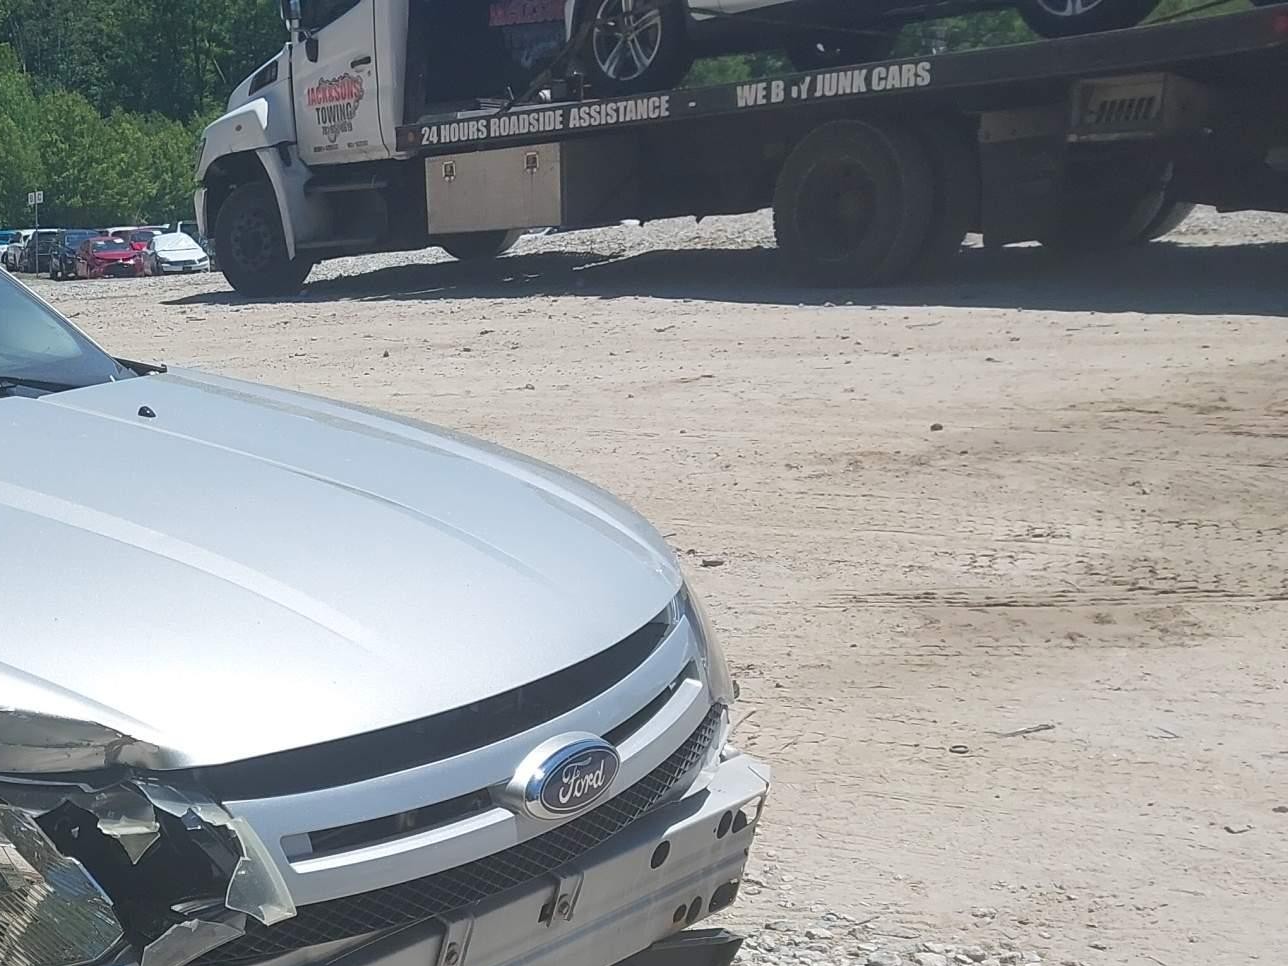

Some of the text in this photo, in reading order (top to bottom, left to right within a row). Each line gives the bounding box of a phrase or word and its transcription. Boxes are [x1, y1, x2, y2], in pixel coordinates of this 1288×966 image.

[736, 61, 931, 108] WE BY JUNK CARS
[315, 102, 353, 125] TOWING
[421, 126, 439, 145] 24
[440, 119, 488, 143] HOURS
[490, 110, 564, 137] ROADSIDE
[568, 95, 670, 128] ASSISTANCE
[558, 756, 606, 804] Ford
